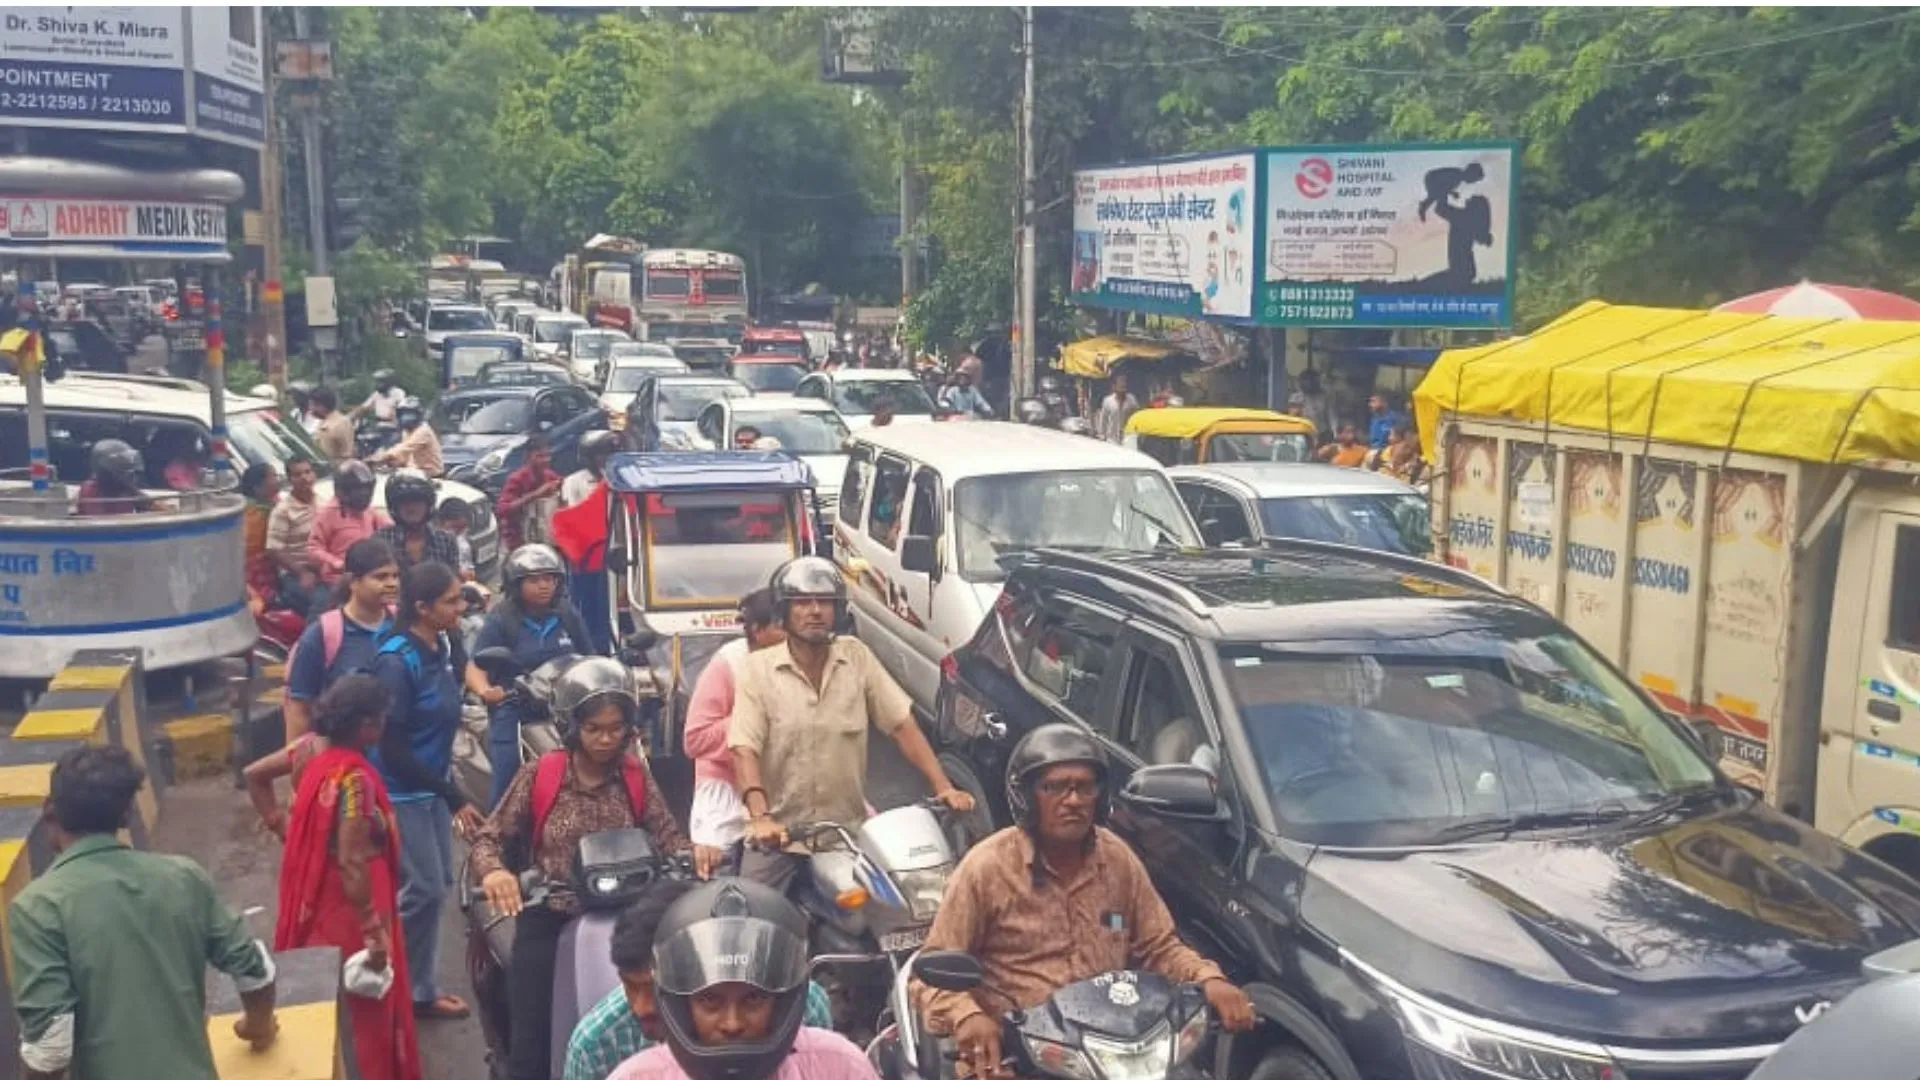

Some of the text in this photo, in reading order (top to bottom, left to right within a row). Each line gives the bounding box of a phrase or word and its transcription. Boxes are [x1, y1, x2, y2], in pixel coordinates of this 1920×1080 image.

[5, 14, 169, 39] Dr. Shiva K. Misra
[102, 97, 172, 114] 2213030
[1337, 158, 1385, 169] SHIVANI
[1337, 172, 1396, 184] HOSPITAL
[1336, 187, 1361, 197] AND
[55, 205, 130, 235] ADHRIT
[136, 206, 189, 237] MEDIA
